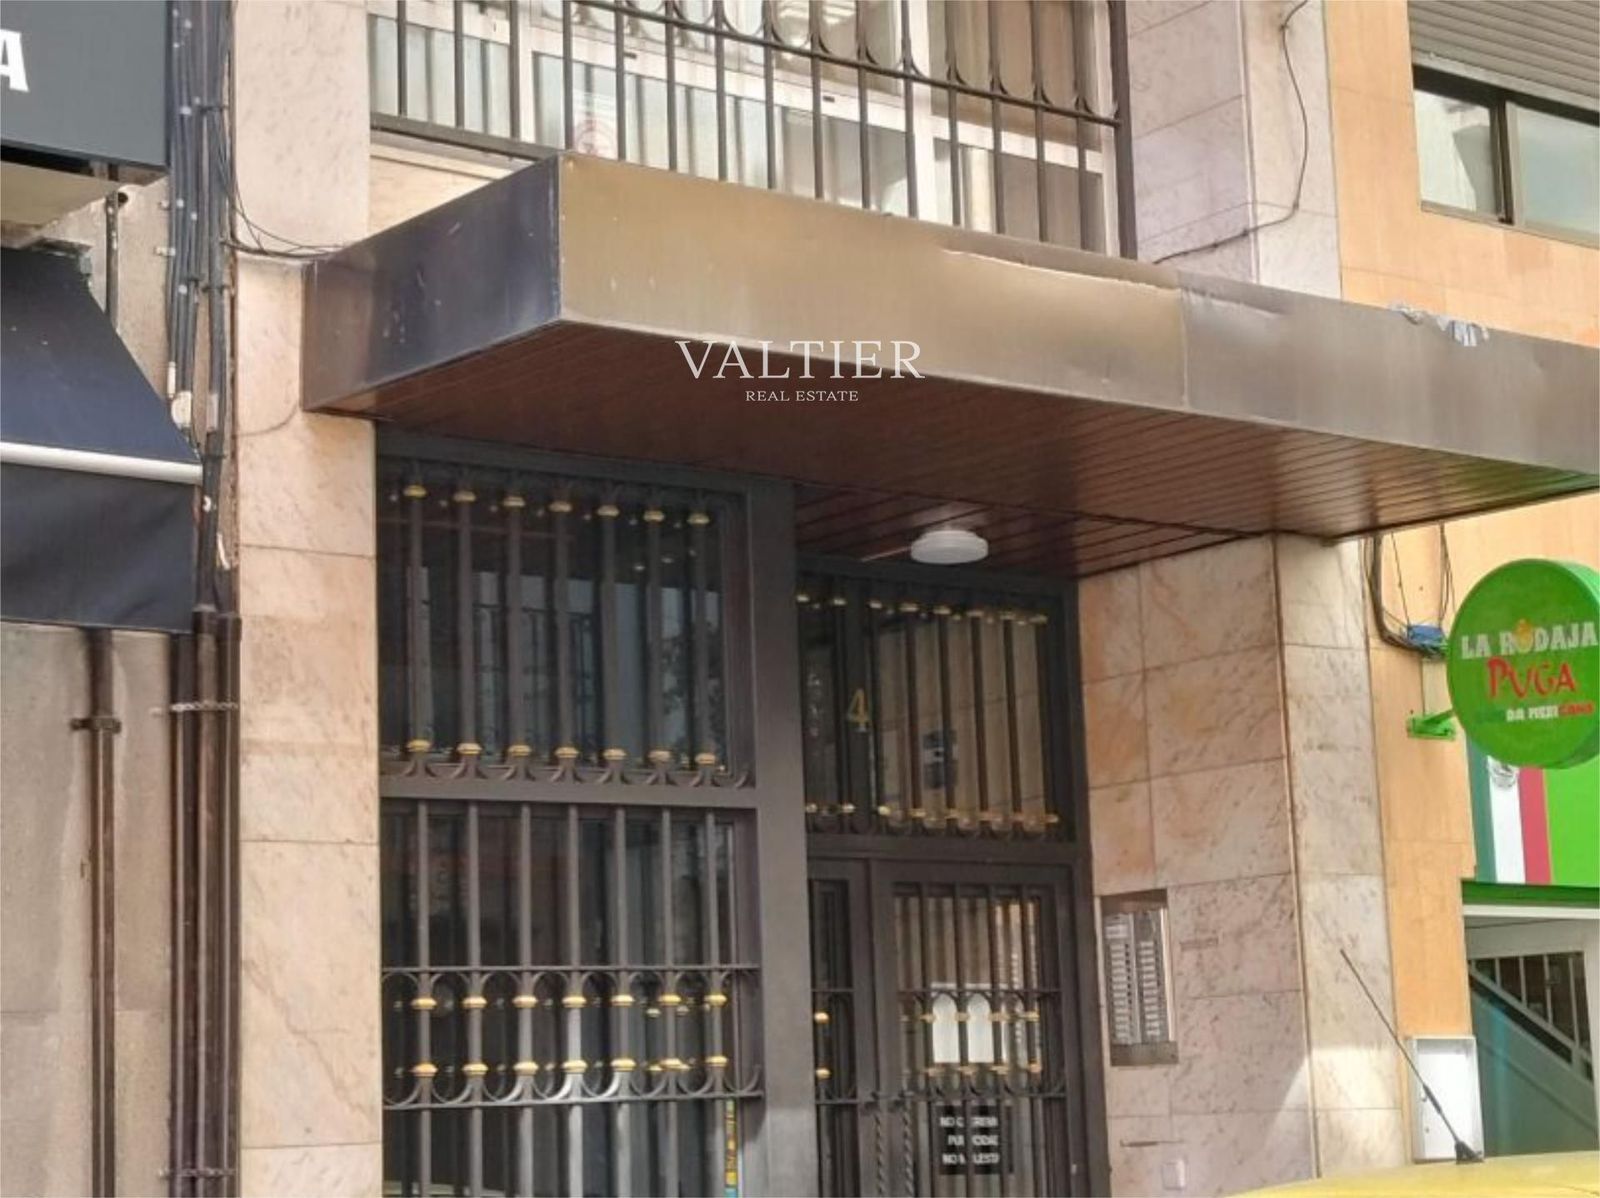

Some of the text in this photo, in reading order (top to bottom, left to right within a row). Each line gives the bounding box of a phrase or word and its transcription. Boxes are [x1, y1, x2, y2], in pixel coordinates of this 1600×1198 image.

[1461, 620, 1598, 660] LA RODAJA
[1487, 656, 1577, 700] PUGA
